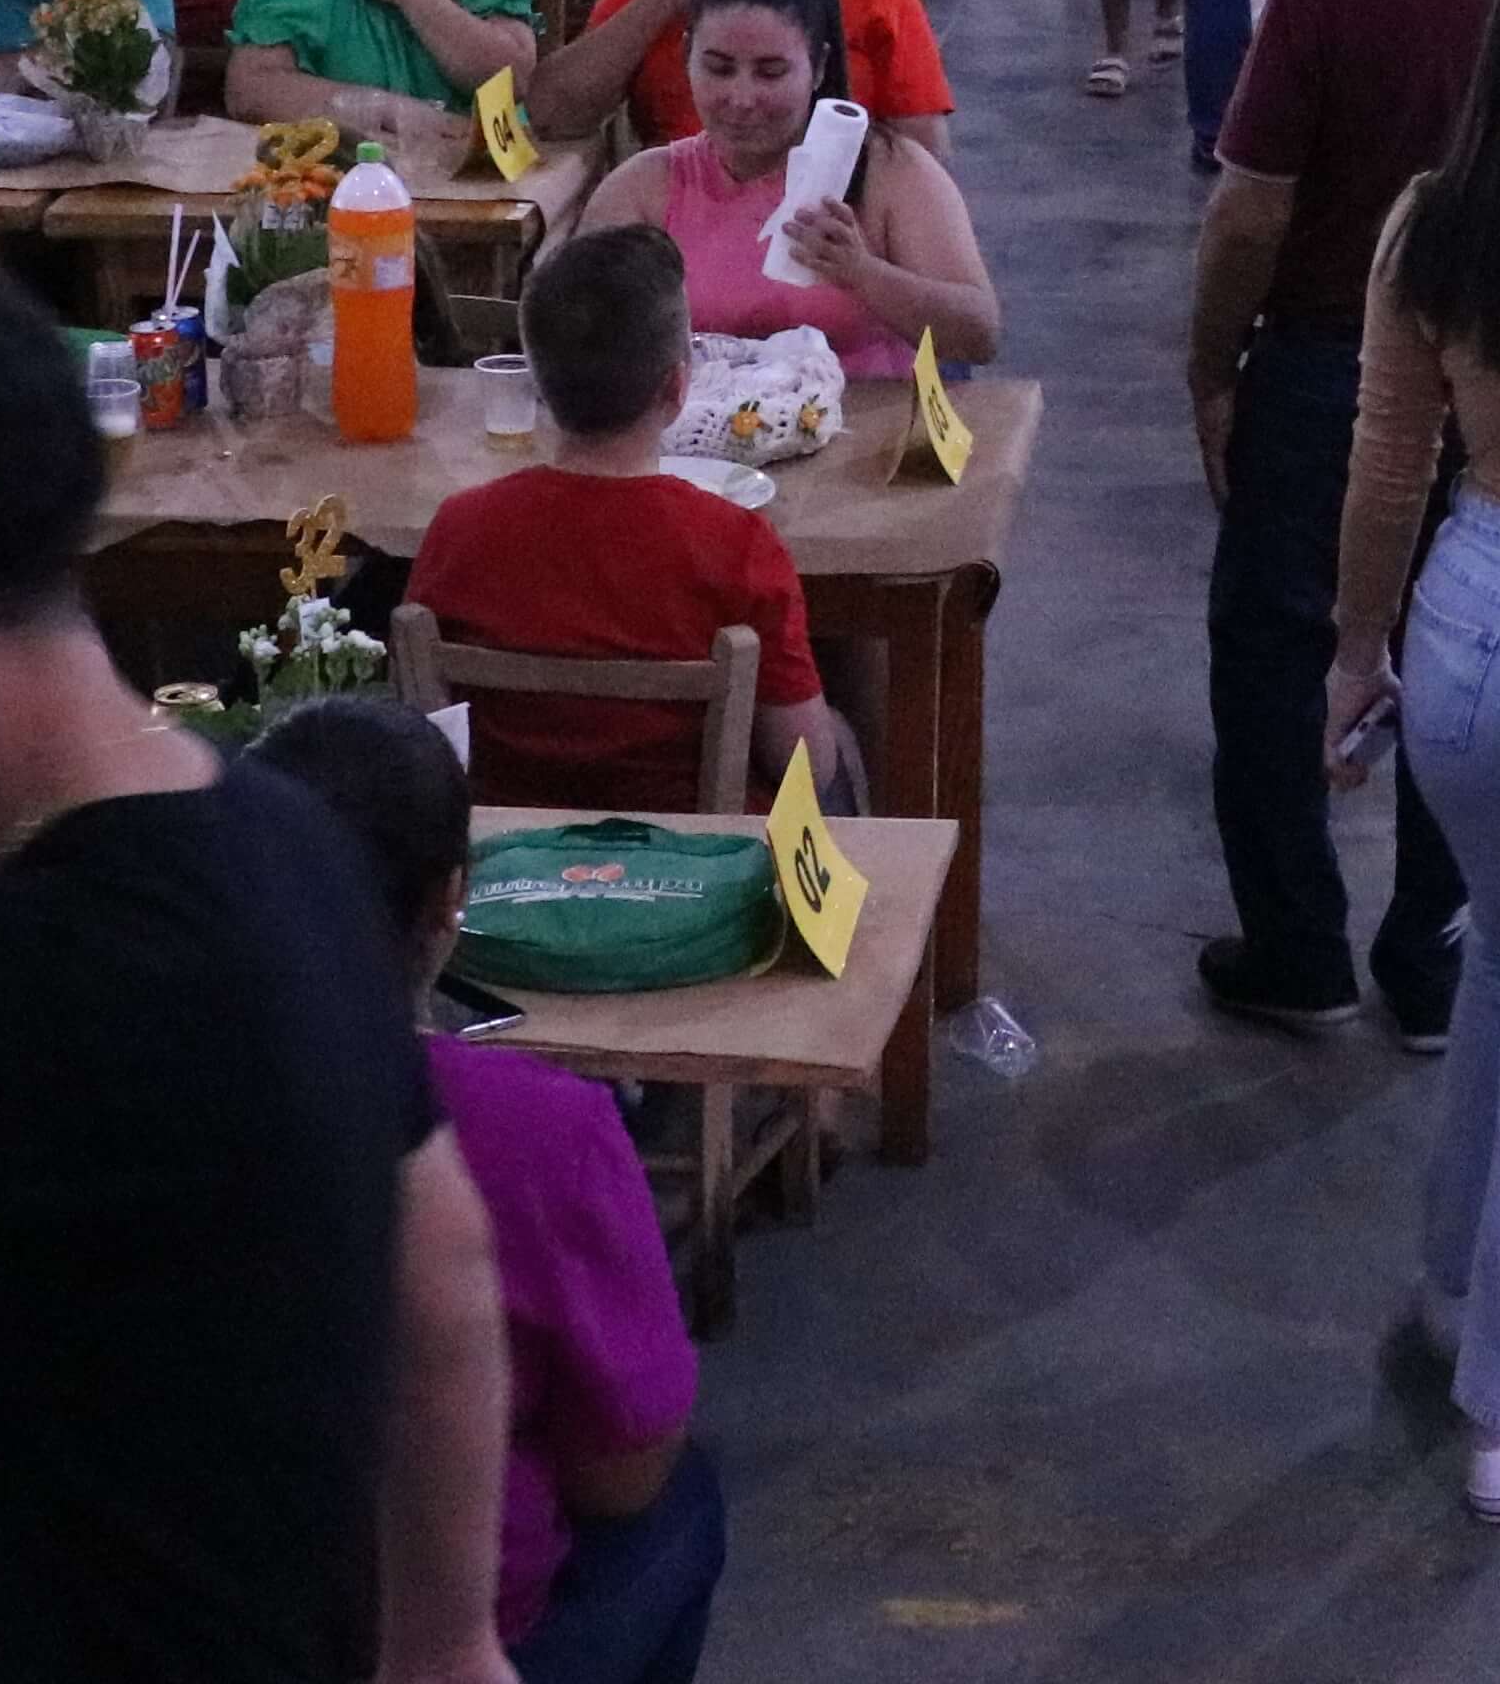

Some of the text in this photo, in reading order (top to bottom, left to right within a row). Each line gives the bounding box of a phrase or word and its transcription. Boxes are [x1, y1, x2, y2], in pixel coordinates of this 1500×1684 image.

[493, 109, 516, 153] 04
[280, 493, 348, 594] 32
[794, 825, 831, 913] 02
